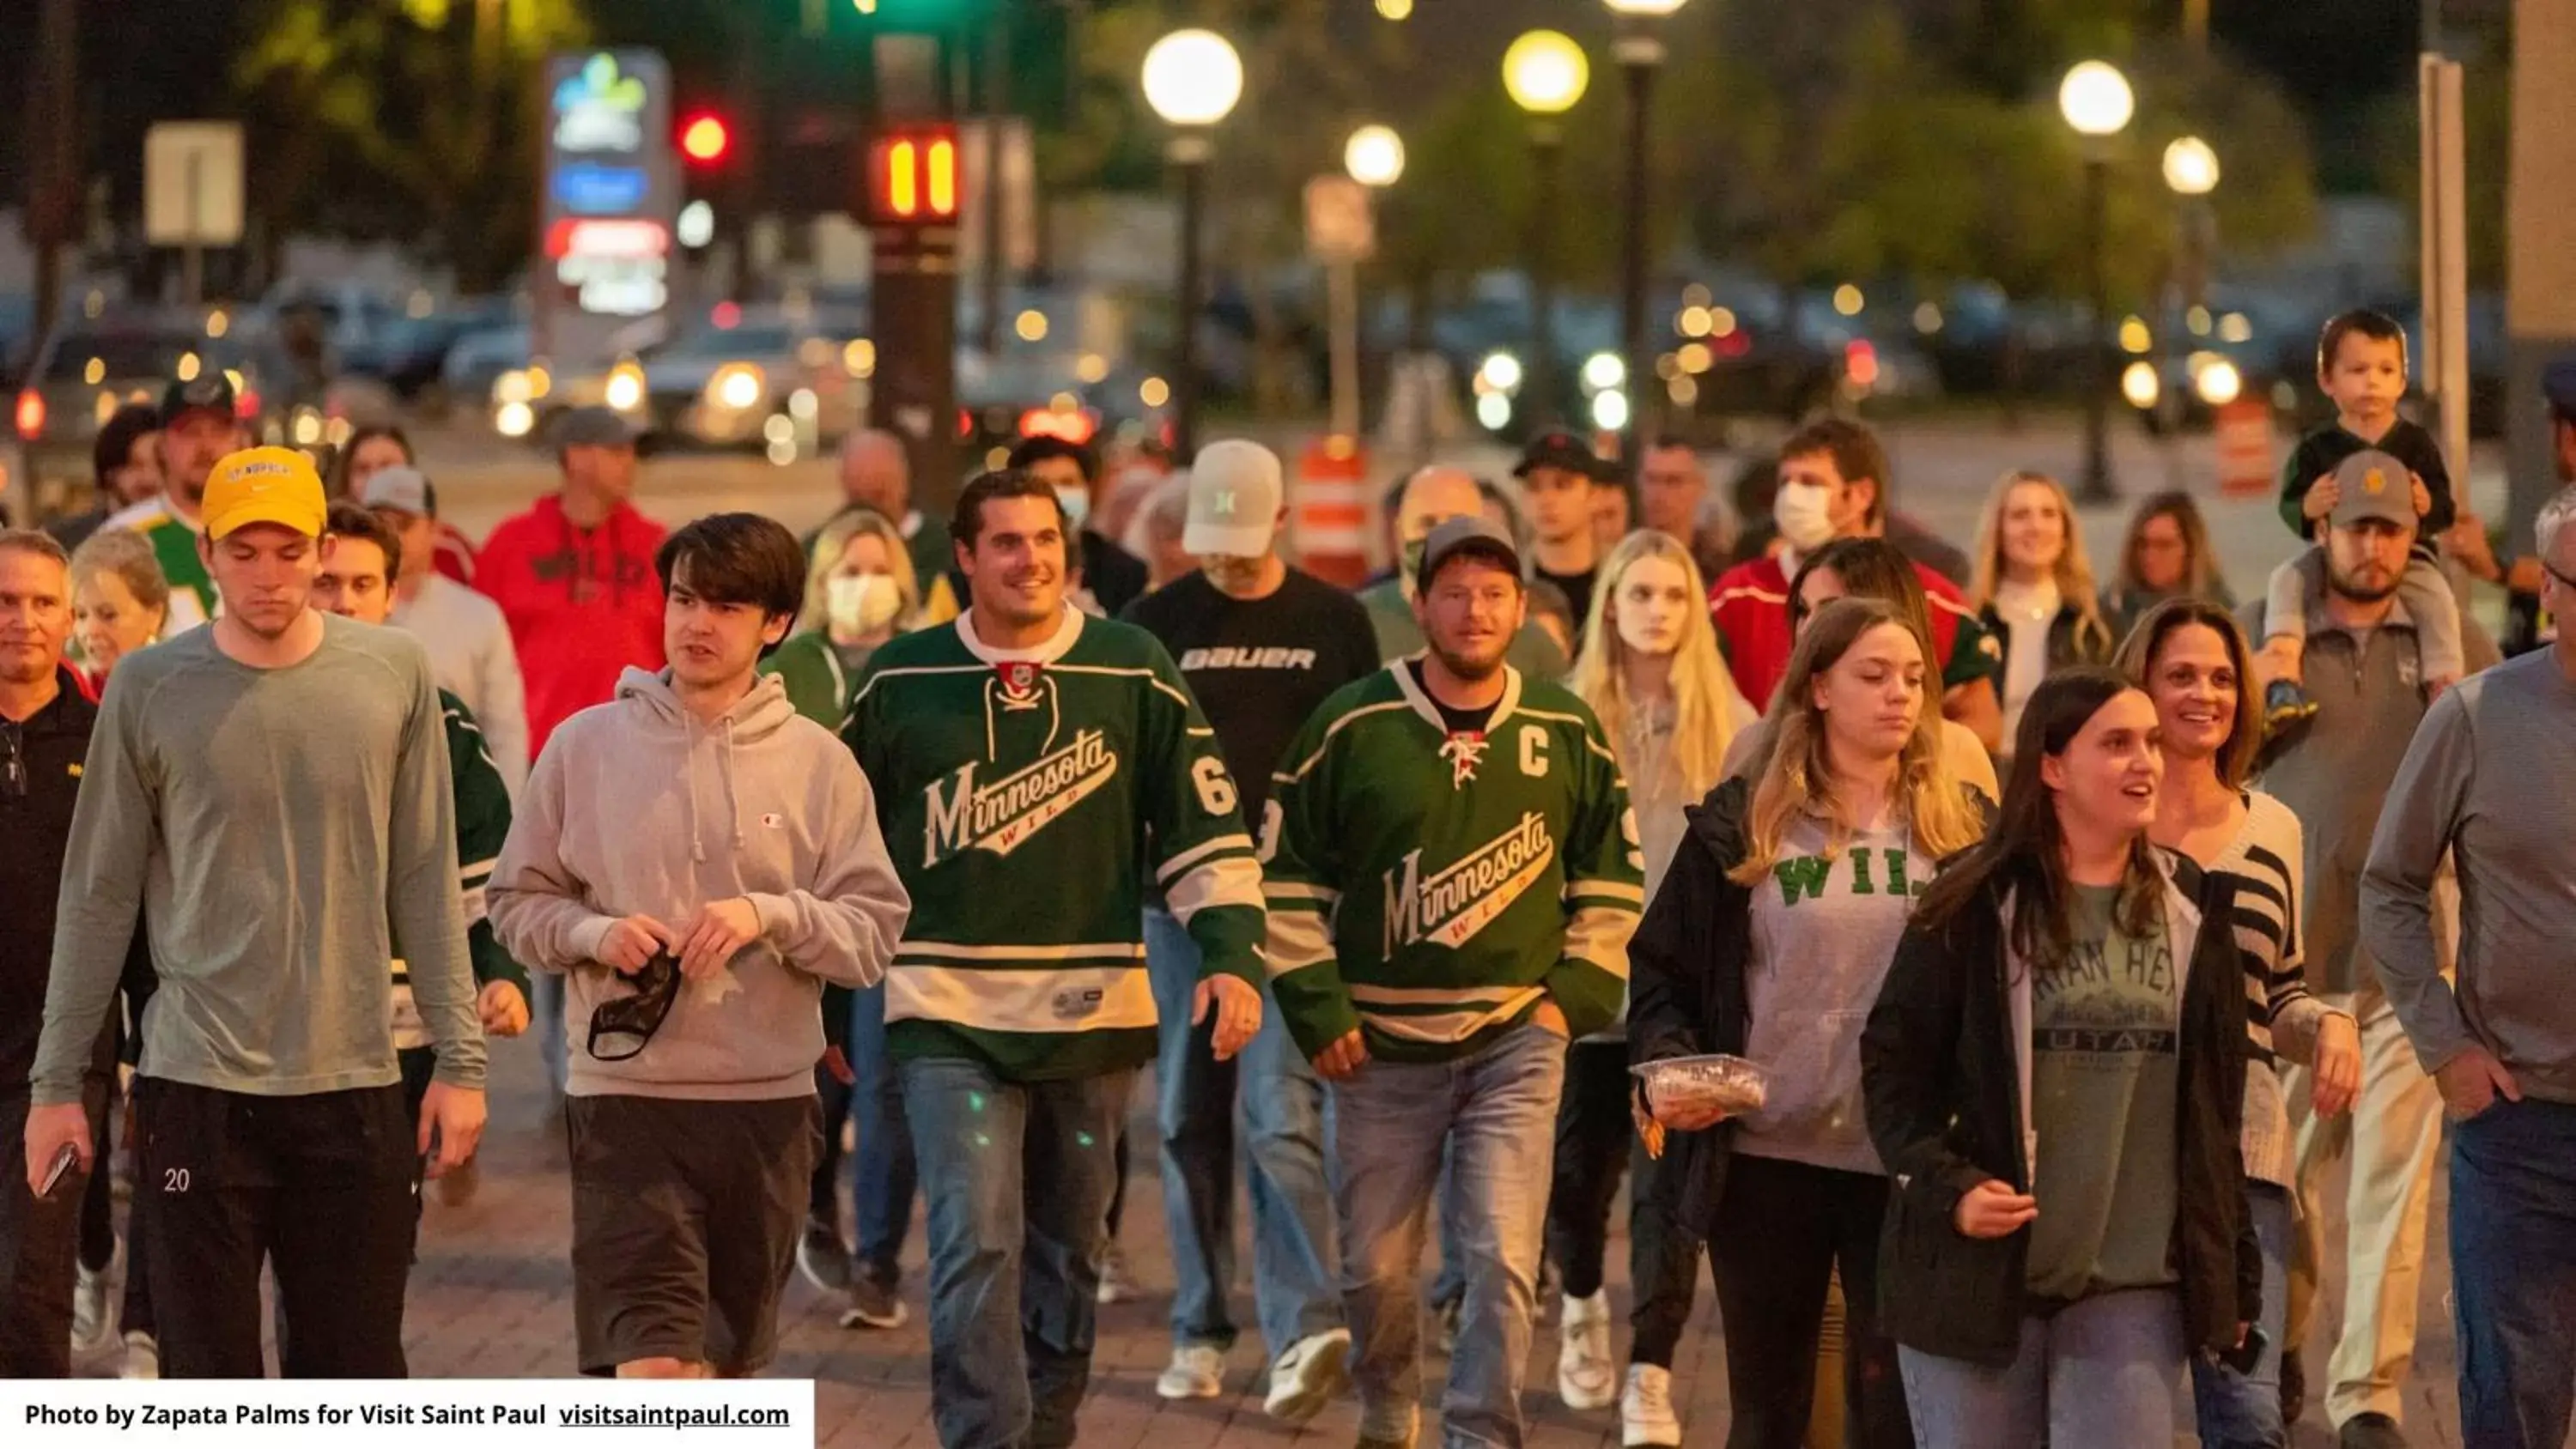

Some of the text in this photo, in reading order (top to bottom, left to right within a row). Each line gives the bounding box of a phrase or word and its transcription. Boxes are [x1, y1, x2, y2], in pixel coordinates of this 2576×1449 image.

[1180, 646, 1316, 670] BAUER
[1519, 724, 1549, 777] C
[922, 729, 1109, 870] Minnesota
[999, 789, 1078, 848] WILD
[1382, 810, 1548, 962] Minnesota
[1773, 847, 1926, 907] WIL
[2125, 943, 2176, 997] HE
[2049, 1029, 2168, 1053] UTAH
[164, 1167, 191, 1193] 20
